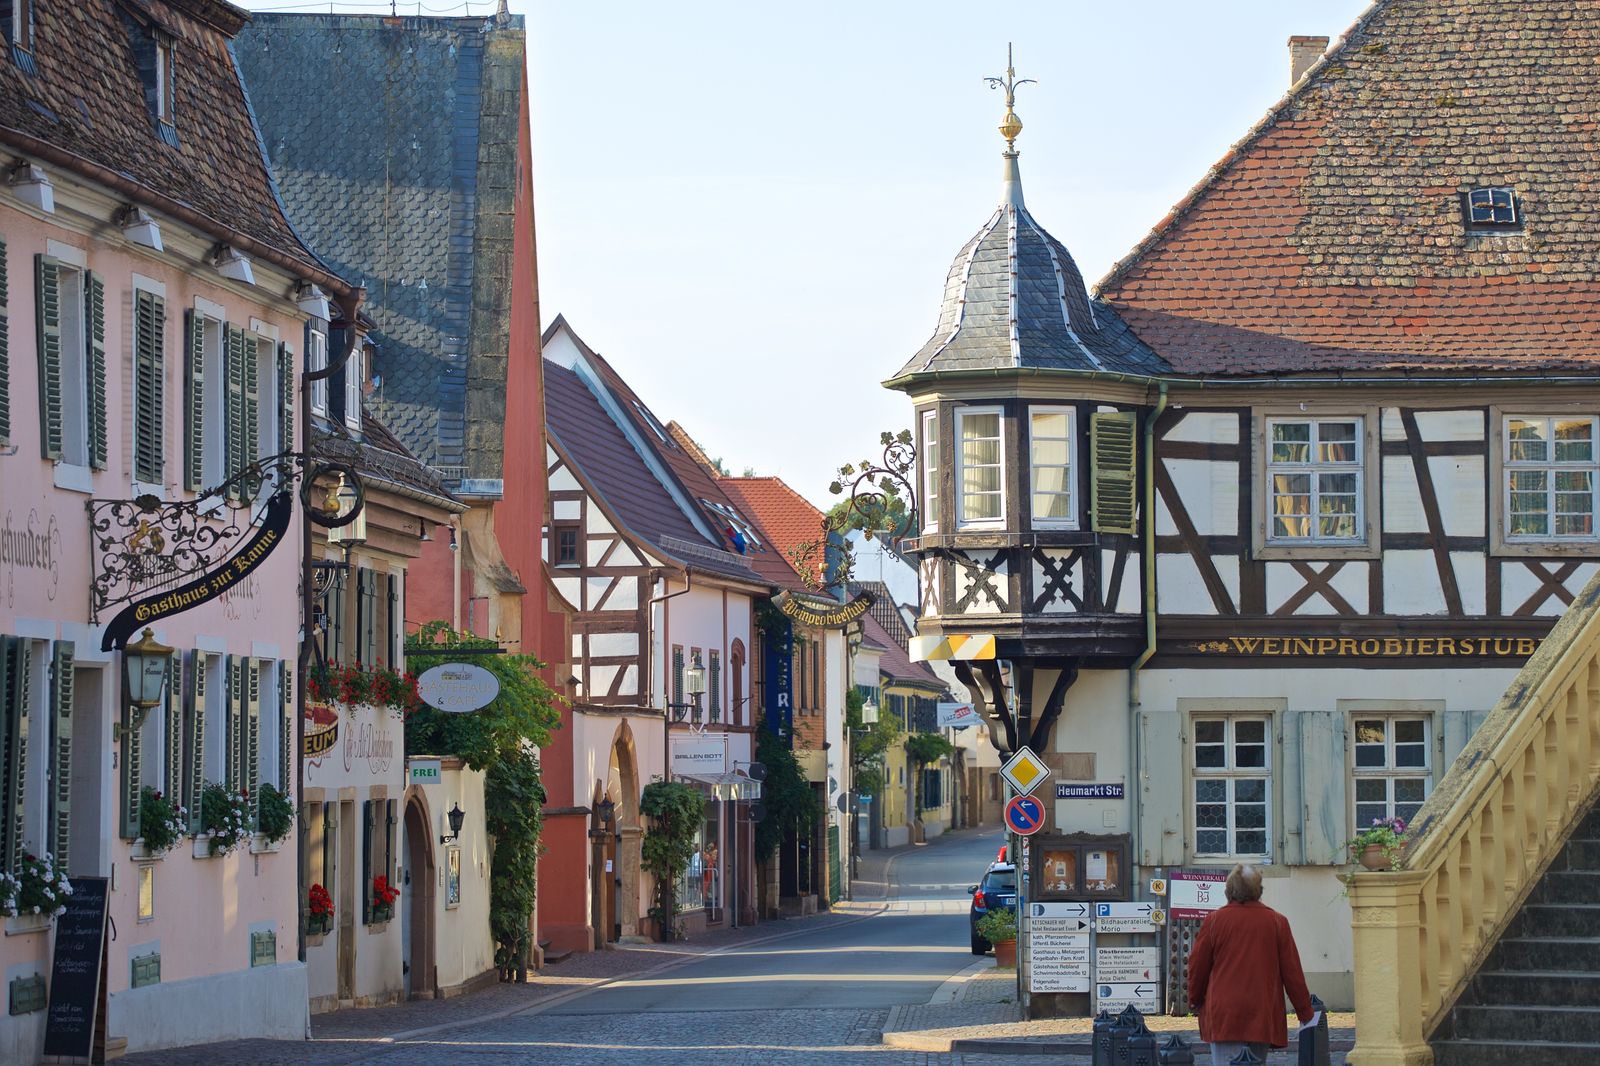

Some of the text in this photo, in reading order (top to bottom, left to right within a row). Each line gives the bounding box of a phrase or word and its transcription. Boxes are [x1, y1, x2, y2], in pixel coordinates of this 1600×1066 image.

[135, 583, 209, 622] Gasthaus
[213, 568, 234, 592] zur
[231, 529, 278, 574] Kanne
[1229, 636, 1545, 657] WEINPROBIERSTUB
[437, 696, 445, 705] &
[413, 768, 437, 777] FREI
[1058, 785, 1123, 796] Heumarkt Str.
[1155, 882, 1161, 890] K
[1099, 905, 1108, 915] P
[1154, 912, 1160, 920] K
